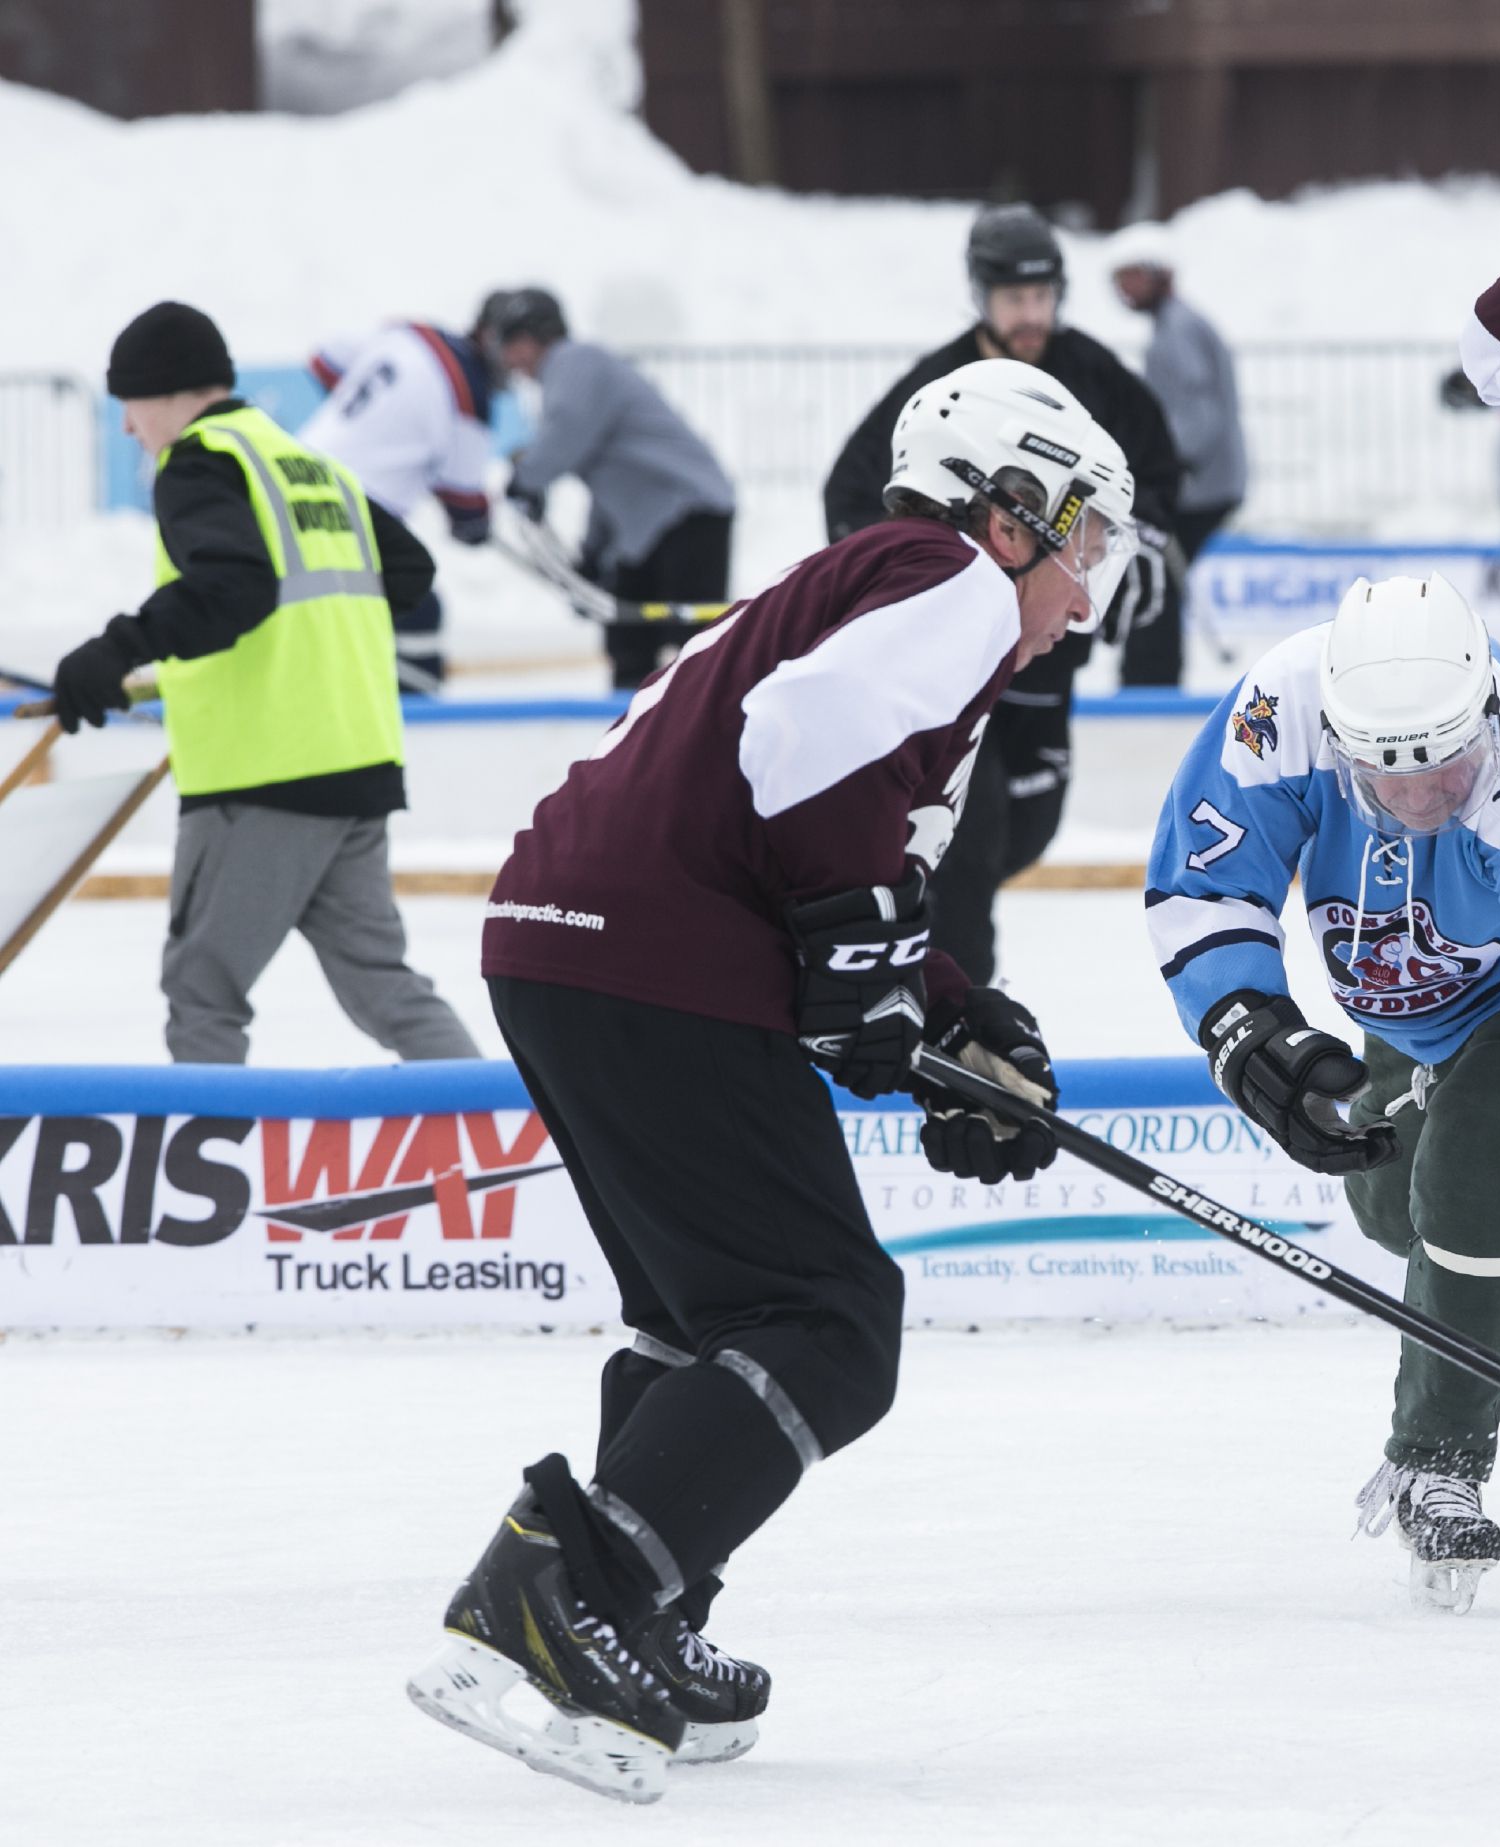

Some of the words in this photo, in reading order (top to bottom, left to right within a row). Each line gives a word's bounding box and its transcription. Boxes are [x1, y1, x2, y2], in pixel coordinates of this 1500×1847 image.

[1185, 800, 1247, 874] 7
[880, 1185, 1108, 1211] TORNEYS
[266, 1253, 391, 1291] Truck
[402, 1253, 566, 1300] Leasing
[921, 1253, 1019, 1280] Tenacity.
[1028, 1252, 1144, 1282] Creativity.
[1152, 1252, 1244, 1276] Results.
